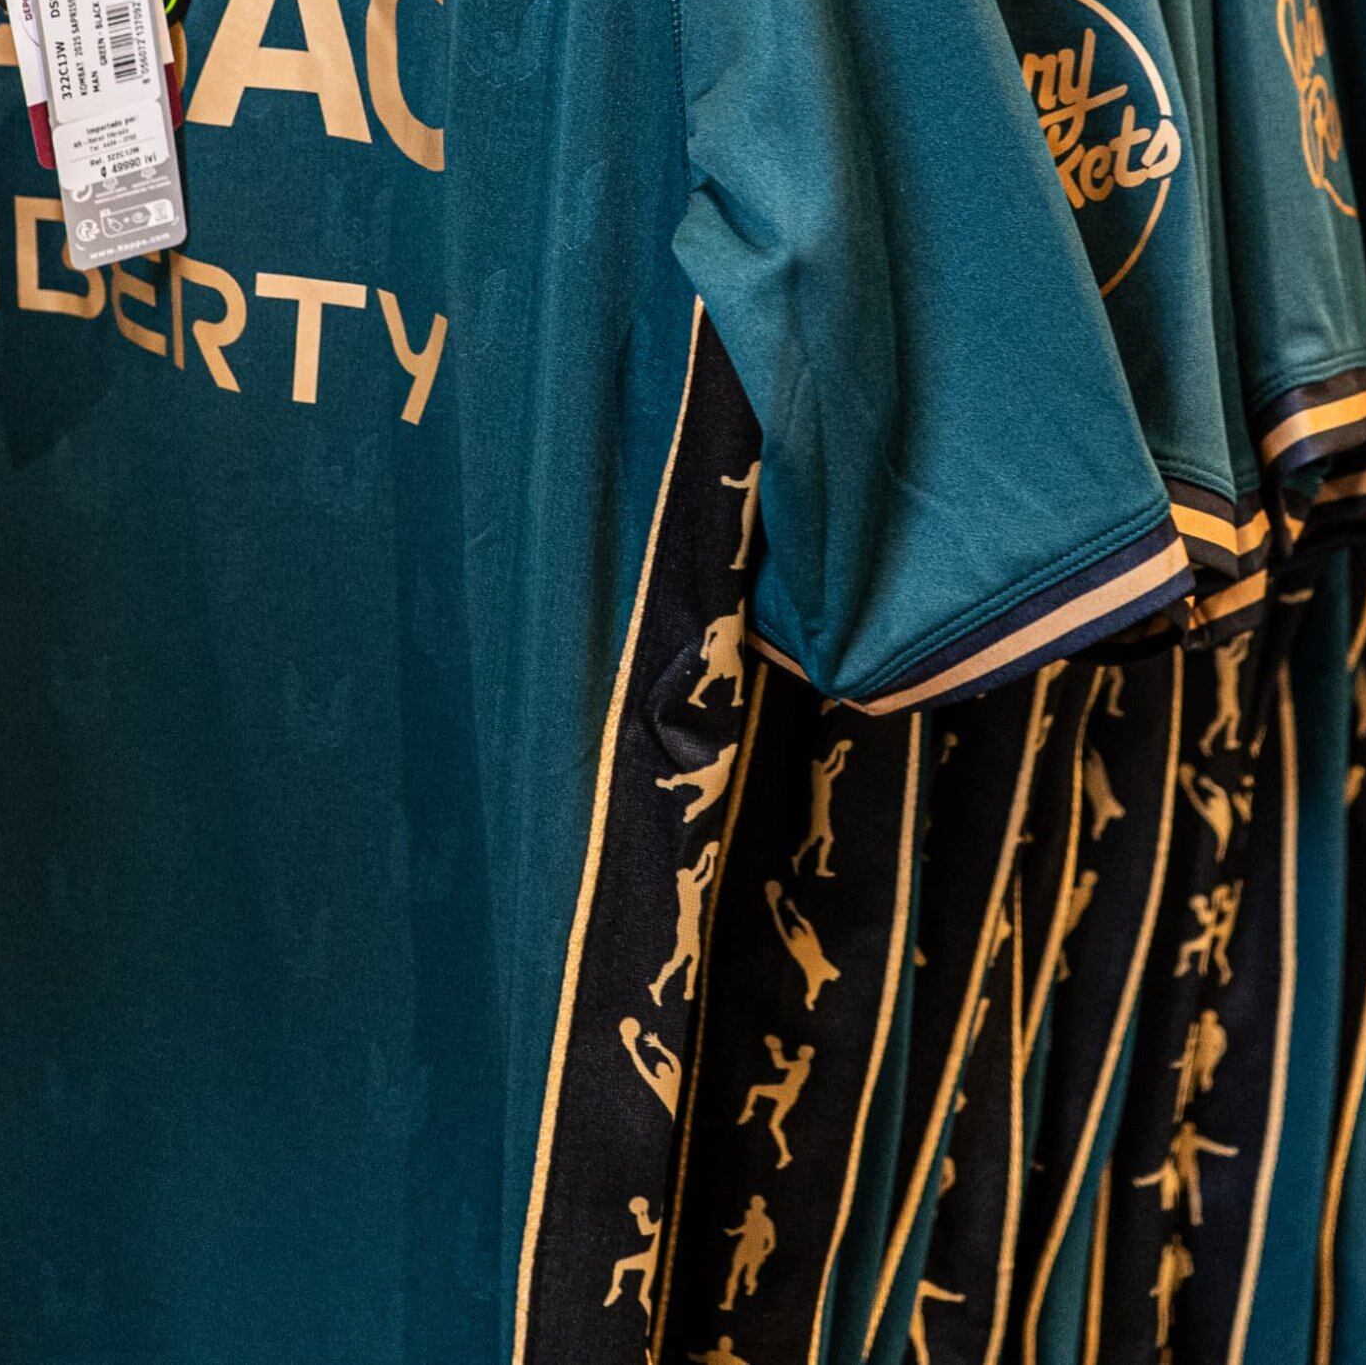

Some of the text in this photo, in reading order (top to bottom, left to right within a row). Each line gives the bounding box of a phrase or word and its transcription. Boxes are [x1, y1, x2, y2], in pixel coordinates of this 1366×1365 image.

[93, 1, 103, 29] BLACK
[72, 36, 83, 57] 2025
[98, 38, 108, 66] GREEN
[55, 41, 73, 100] 322C1JW
[76, 62, 88, 96] KOMBAT
[91, 70, 101, 93] MAN
[111, 157, 141, 174] 49990
